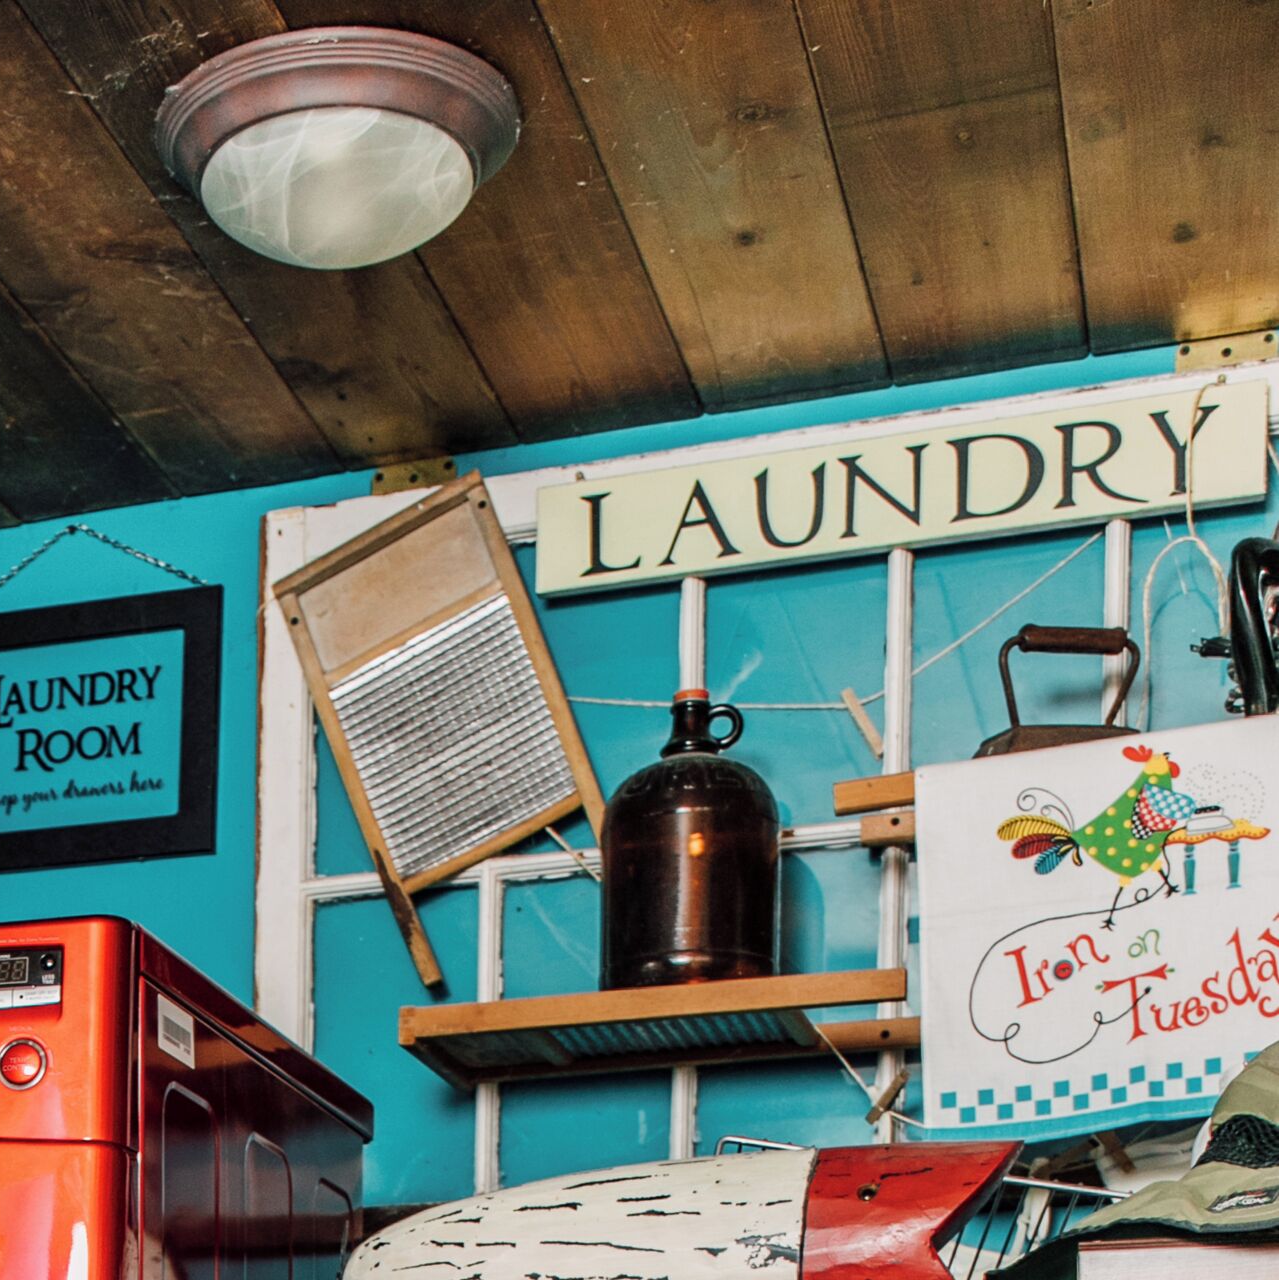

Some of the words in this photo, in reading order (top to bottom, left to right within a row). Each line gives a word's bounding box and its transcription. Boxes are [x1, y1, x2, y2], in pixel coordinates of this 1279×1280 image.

[579, 404, 1221, 578] LAUNDRY
[14, 722, 142, 772] ROOM
[22, 788, 58, 812] your
[63, 780, 125, 799] drawers
[129, 771, 164, 793] here
[1004, 934, 1111, 1009] Iron
[1128, 928, 1162, 959] on
